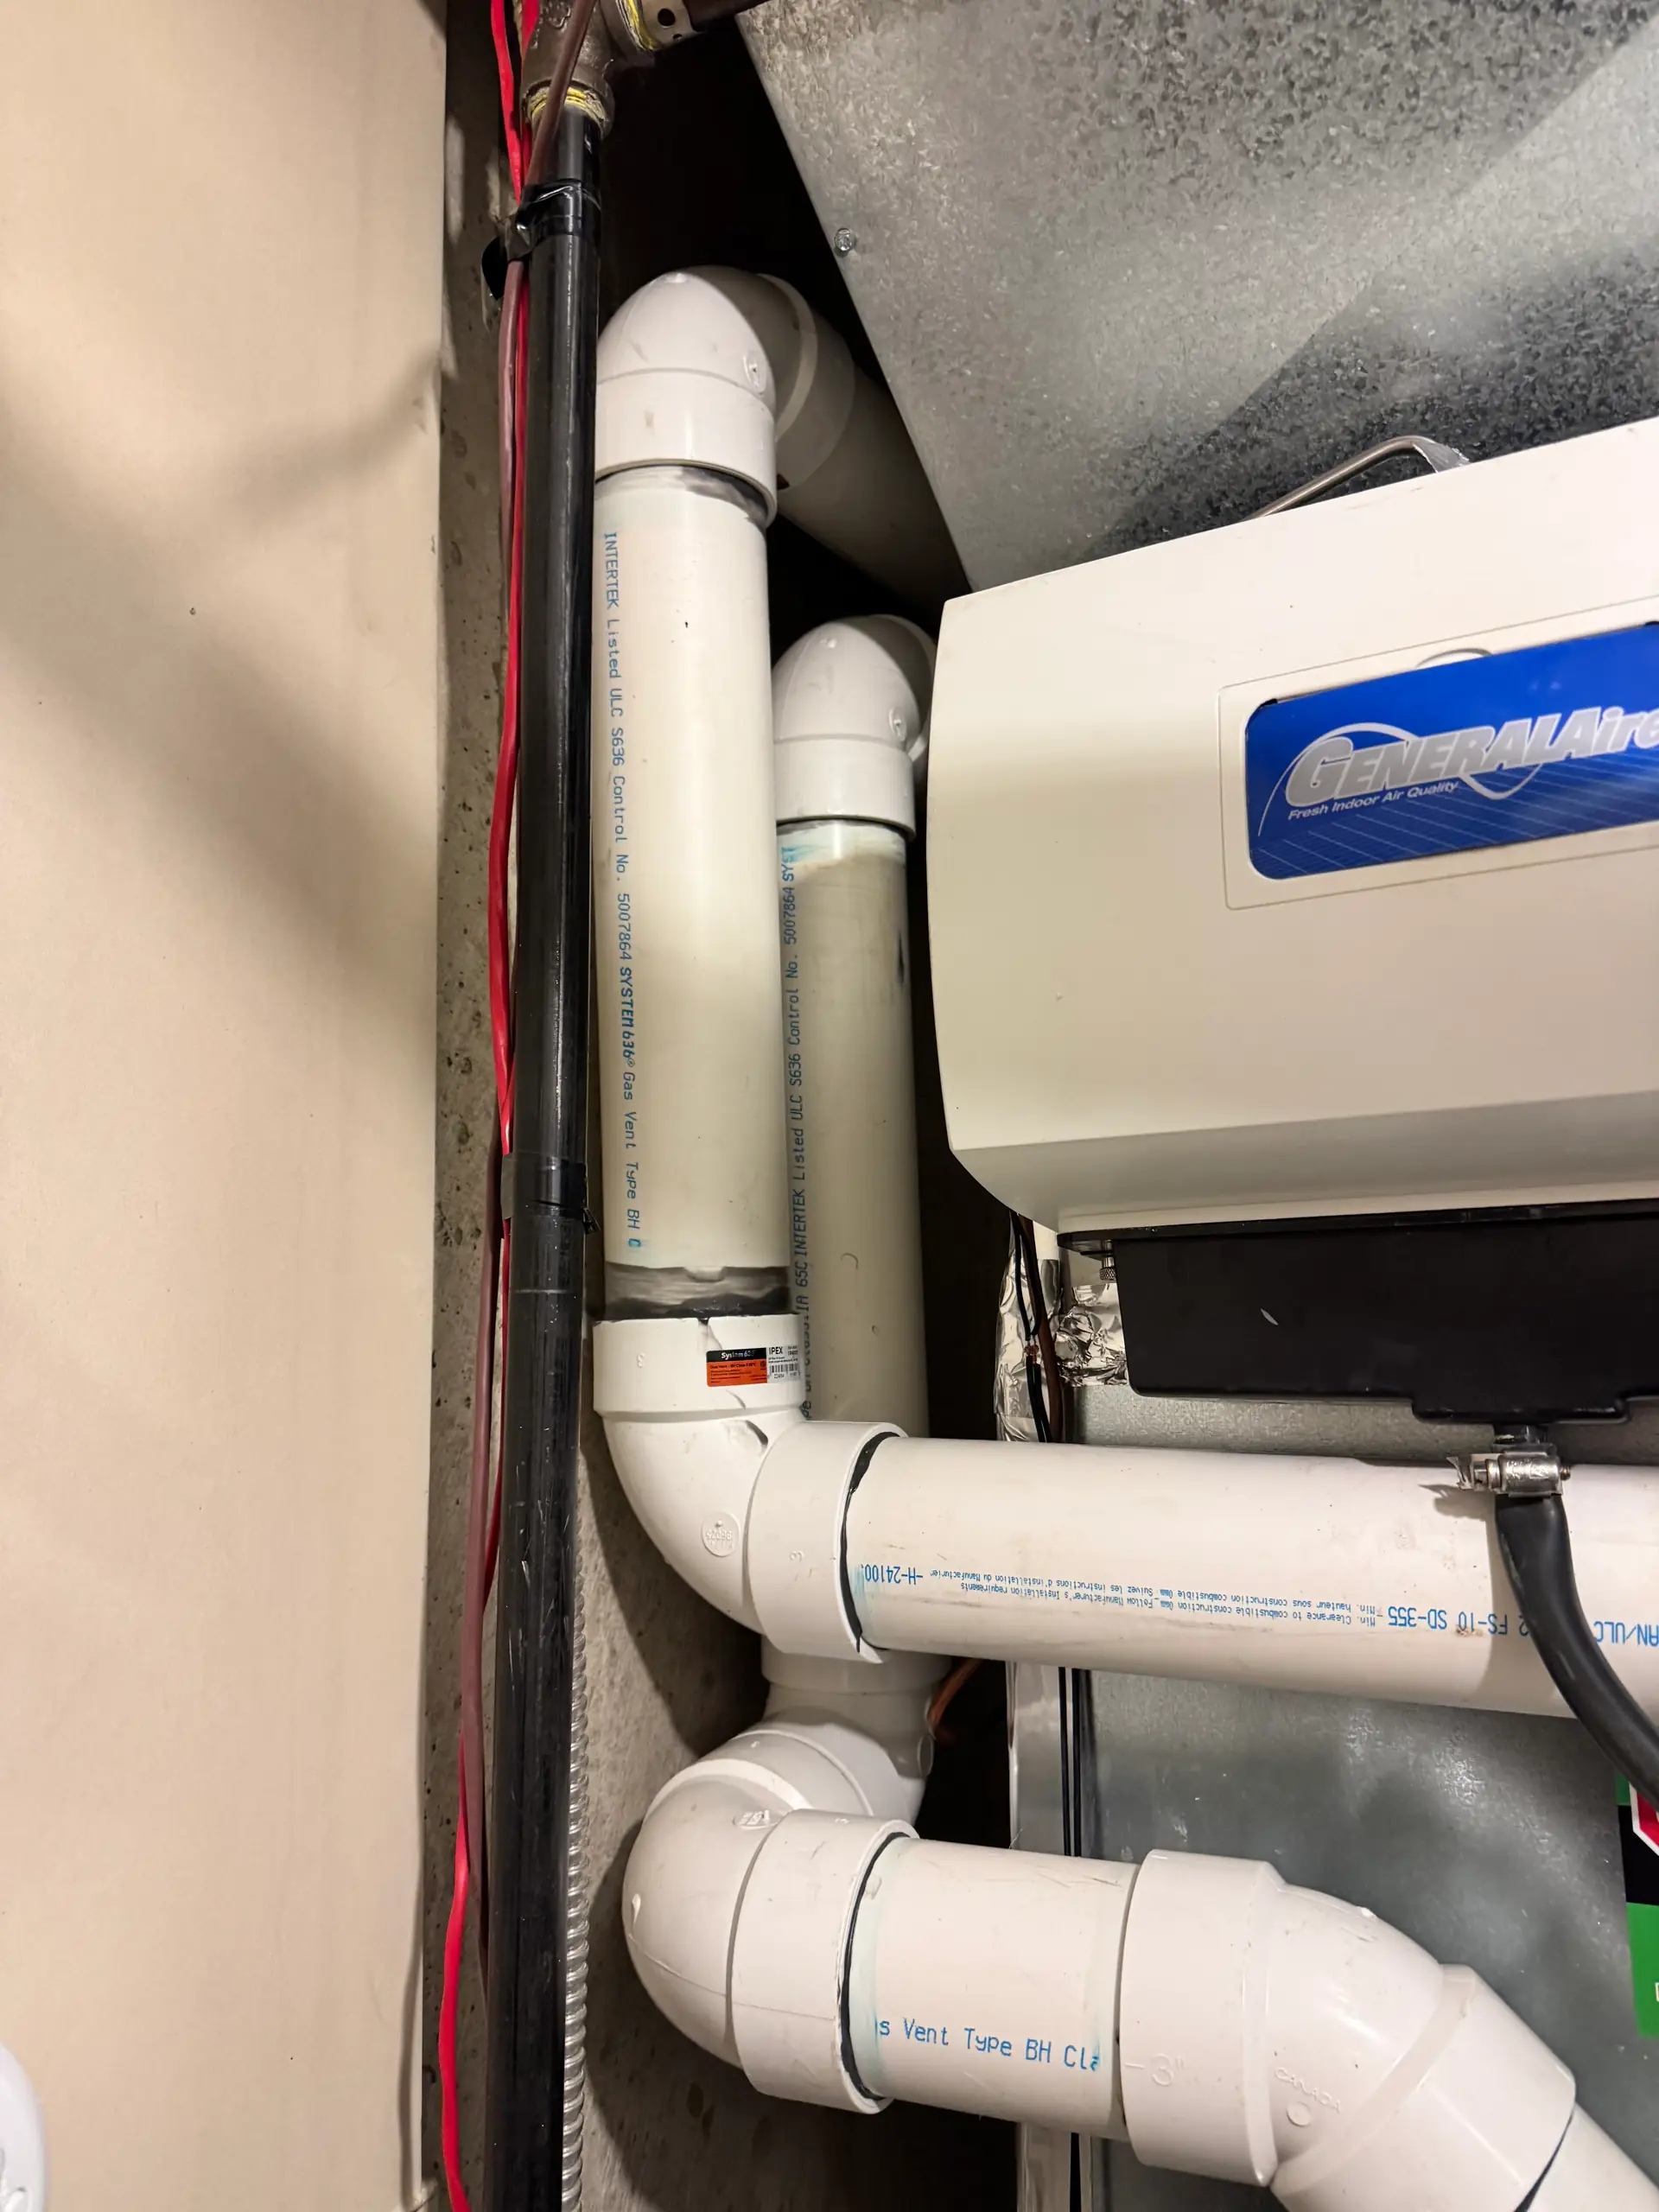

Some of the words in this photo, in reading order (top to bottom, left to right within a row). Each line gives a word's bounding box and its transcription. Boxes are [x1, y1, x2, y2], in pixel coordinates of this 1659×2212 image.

[604, 531, 620, 610] INTERTEK
[607, 619, 622, 678] Listed
[611, 687, 624, 717] ULC
[612, 728, 625, 767] S636
[613, 776, 628, 843] Control
[1287, 804, 1329, 821] Fresh
[1331, 796, 1380, 812] Indoor
[1382, 791, 1404, 803] Air
[1407, 780, 1459, 798] Quality
[615, 854, 629, 882] No.
[617, 892, 632, 961] 5007864
[782, 887, 797, 945] 5007864
[785, 955, 798, 979] No.
[786, 988, 800, 1046] Control
[787, 1053, 803, 1087] S636
[621, 1071, 636, 1101] Gas
[789, 1095, 803, 1122] ULC
[623, 1111, 638, 1150] Vent
[791, 1128, 805, 1180] Listed
[625, 1161, 640, 1199] Type
[626, 1208, 641, 1230] BH
[791, 1189, 807, 1258] INTERTEK
[768, 1346, 784, 1355] IPEX
[930, 1568, 981, 1582] Manufacturier
[983, 1573, 992, 1583] du
[995, 1574, 1053, 1588] d'installation
[1055, 1580, 1106, 1594] instructions
[961, 1582, 1008, 1595] requirements
[1010, 1586, 1060, 1600] Installation
[1064, 1591, 1124, 1606] Manufacturer's
[1110, 1584, 1122, 1596] les
[1127, 1586, 1154, 1598] Suivez
[1178, 1589, 1227, 1603] combustible
[1178, 1602, 1232, 1617] construction
[1230, 1594, 1288, 1609] construction
[1236, 1606, 1288, 1620] combustible
[1292, 1599, 1312, 1610] sous
[1315, 1601, 1351, 1613] hauteur
[1293, 1611, 1302, 1621] to
[1306, 1611, 1351, 1625] Clearance
[1388, 1606, 1448, 1630] SD-355
[1458, 1611, 1508, 1635] FS-10
[903, 2016, 950, 2046] Vent
[964, 2027, 1013, 2057] Type
[1025, 2037, 1052, 2063] BH
[1274, 2066, 1342, 2114] CANADA
